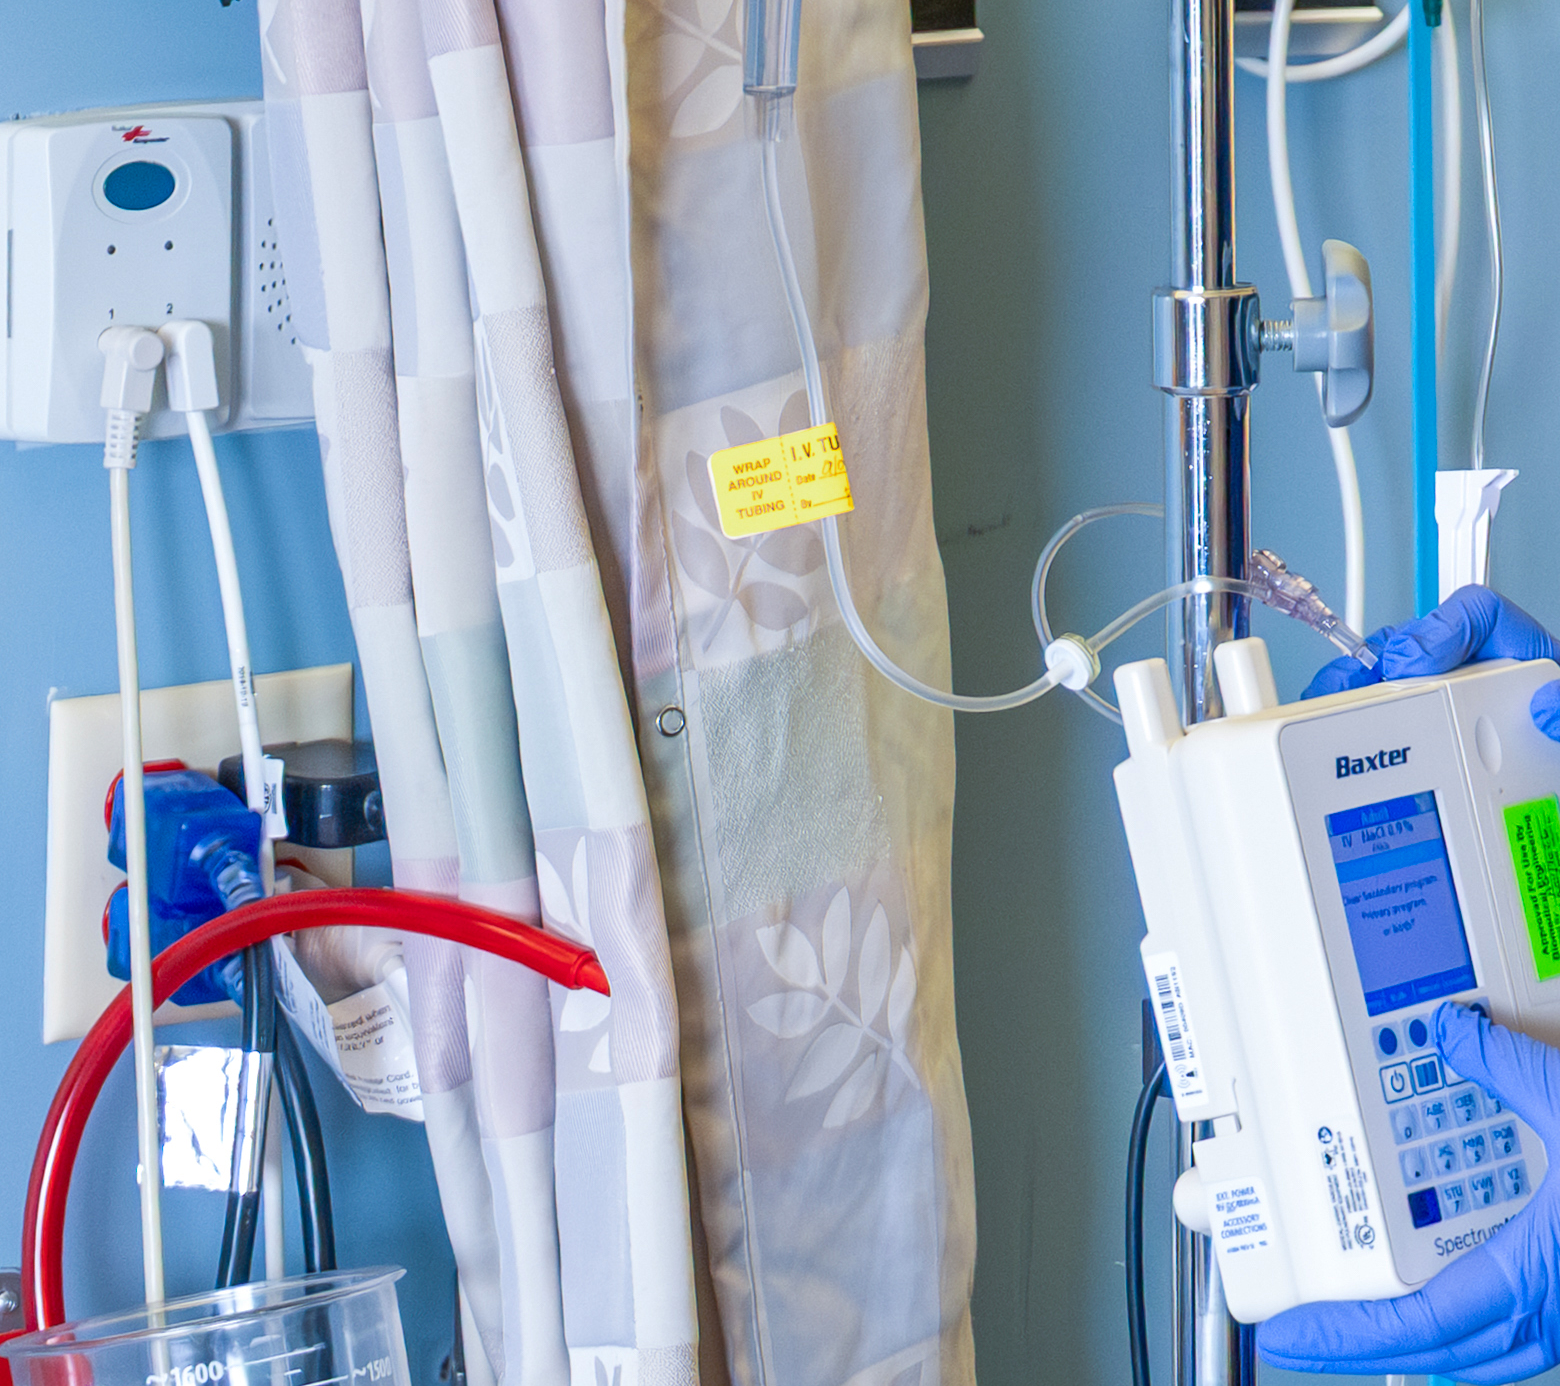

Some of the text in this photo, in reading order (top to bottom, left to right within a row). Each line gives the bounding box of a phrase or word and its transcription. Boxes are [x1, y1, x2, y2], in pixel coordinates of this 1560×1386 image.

[732, 457, 771, 474] WRAP
[728, 470, 782, 492] AROUND
[751, 489, 763, 501] IV
[736, 499, 786, 519] TUBING
[1335, 745, 1411, 780] Baxter
[1523, 814, 1548, 890] Engineering
[1514, 823, 1551, 956] Approved For Use By
